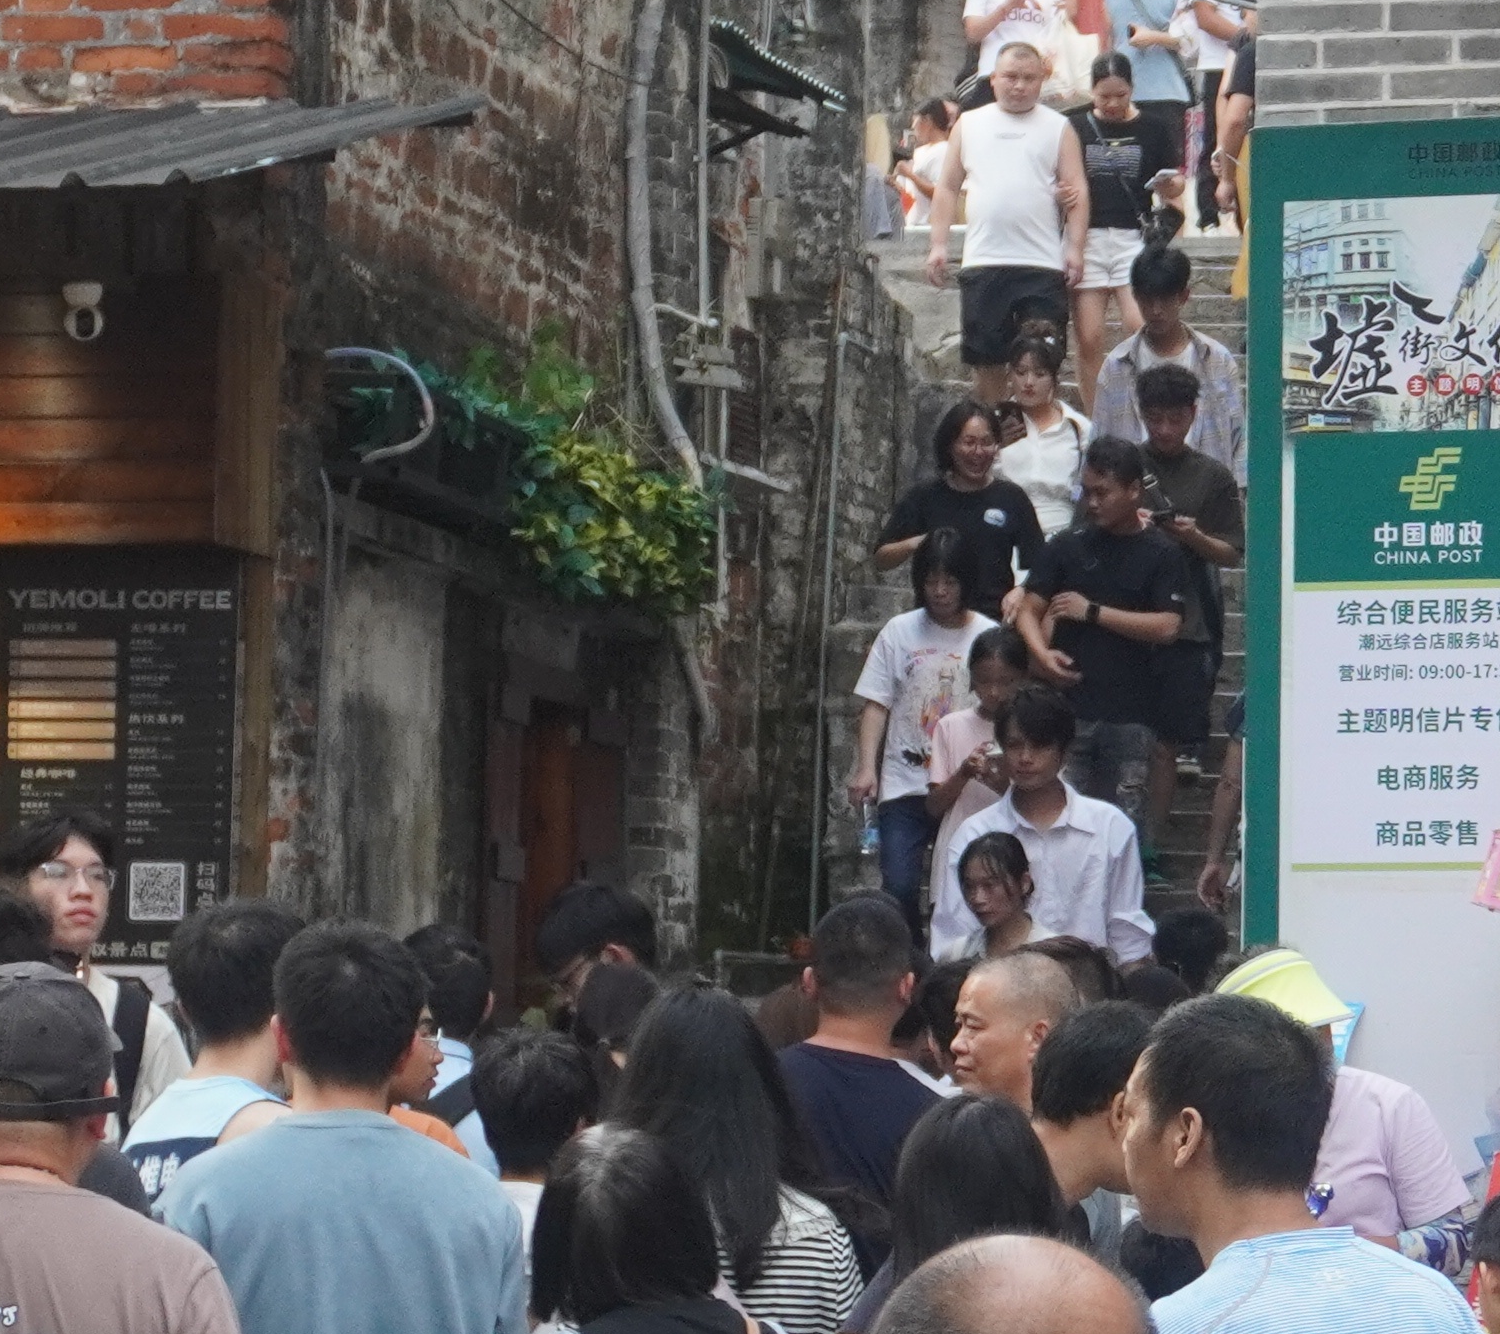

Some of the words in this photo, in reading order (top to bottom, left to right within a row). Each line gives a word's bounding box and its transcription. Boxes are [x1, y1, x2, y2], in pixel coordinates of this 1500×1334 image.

[1374, 520, 1483, 549] 中国邮政
[1374, 550, 1431, 565] CHINA
[1438, 549, 1483, 563] POST
[8, 589, 125, 609] YEMOLI
[132, 589, 232, 610] COFFEE
[1358, 631, 1500, 651] 潮远综合店服务站
[1377, 764, 1480, 791] 电商服务
[1376, 819, 1480, 848] 商品零售
